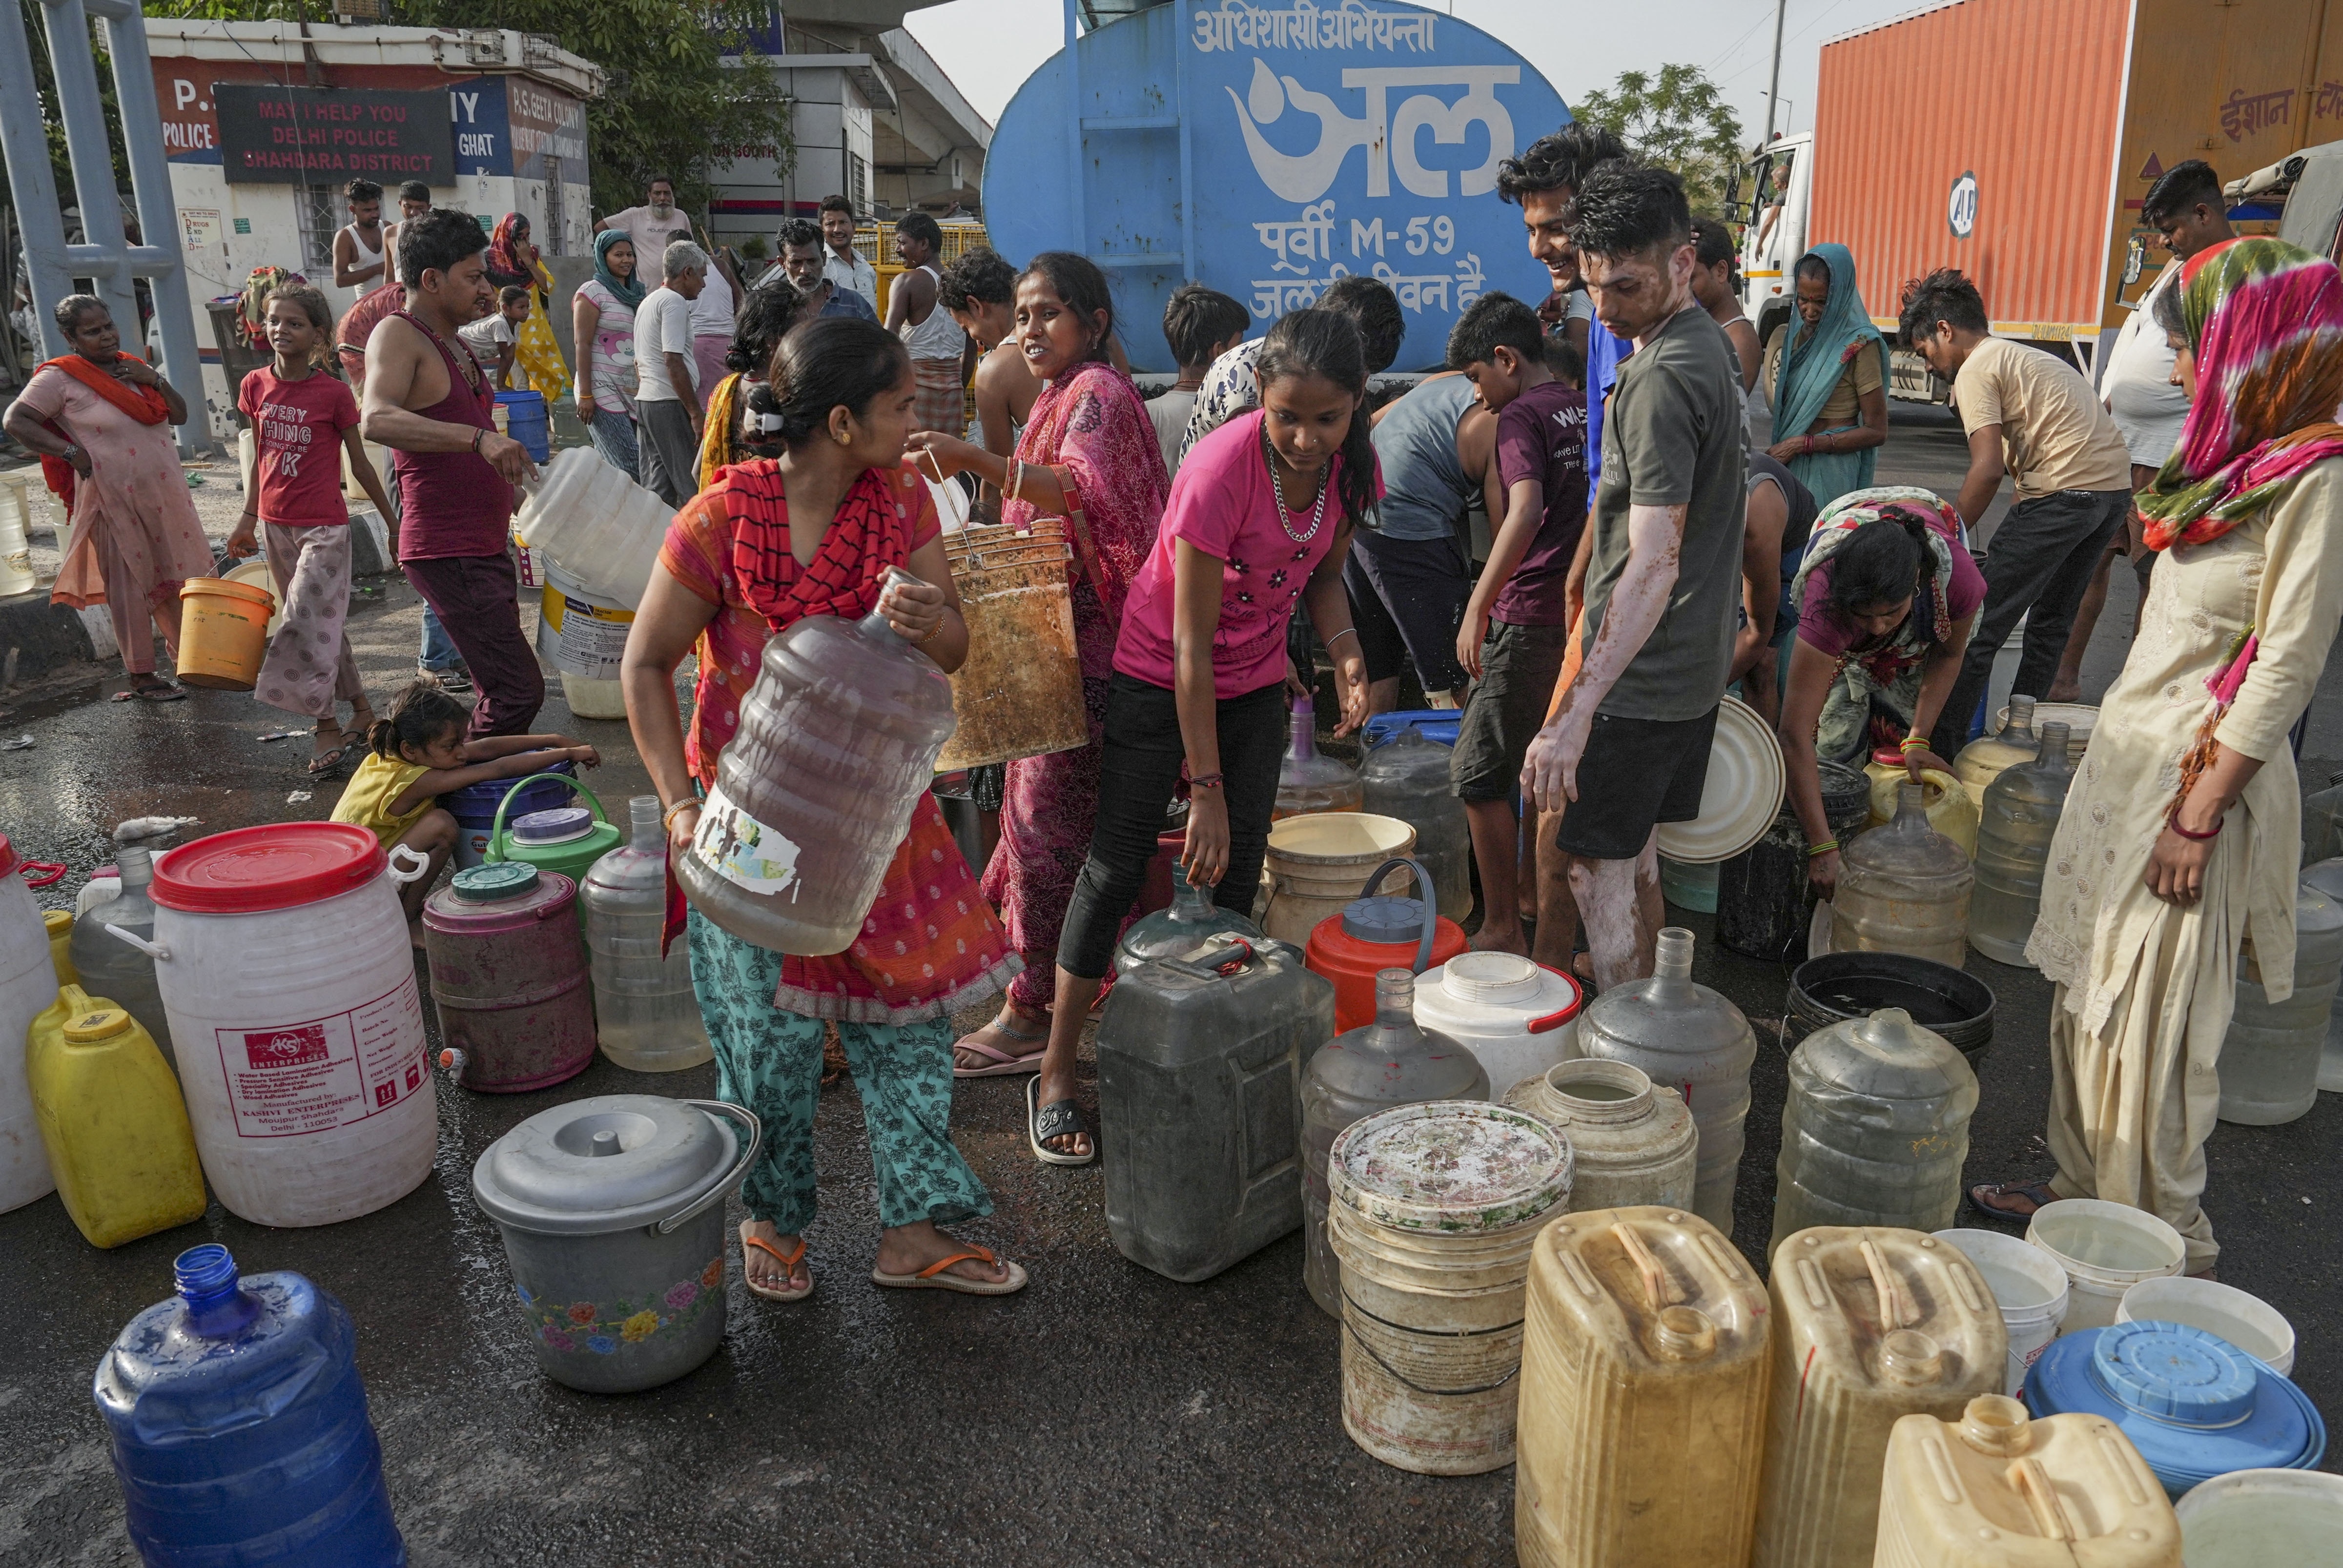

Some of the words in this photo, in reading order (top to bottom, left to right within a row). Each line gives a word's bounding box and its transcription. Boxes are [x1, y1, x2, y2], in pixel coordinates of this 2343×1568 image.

[258, 101, 297, 119] MAY
[304, 102, 309, 120] I
[316, 103, 363, 122] HELP
[369, 104, 407, 123] YOU
[554, 101, 578, 129] COLONY
[2220, 88, 2295, 143] ईशान
[163, 122, 213, 149] POLICE
[272, 126, 327, 145] DELHI
[333, 128, 399, 147] POLICE
[459, 133, 494, 156] GHAT
[244, 150, 345, 170] SHAHDARA
[349, 153, 433, 172] DISTRICT
[1350, 215, 1455, 259] M-59
[262, 402, 307, 423] EVERY
[265, 440, 284, 450] GOING
[281, 452, 302, 477] K
[253, 1053, 326, 1068] ENTERPRISES
[282, 1066, 320, 1076] Lamination
[321, 1057, 353, 1069] Adhesives
[273, 1079, 308, 1088] Adhesives
[301, 1068, 334, 1079] Adhesives
[292, 1081, 327, 1091] Adhesives
[264, 1095, 322, 1108] Manufactured
[288, 1093, 360, 1114] ENTERPRISES
[259, 1116, 298, 1124] Moujpur
[301, 1107, 344, 1120] Shahdara
[271, 1123, 294, 1132] Delhi
[304, 1116, 338, 1128] 110053
